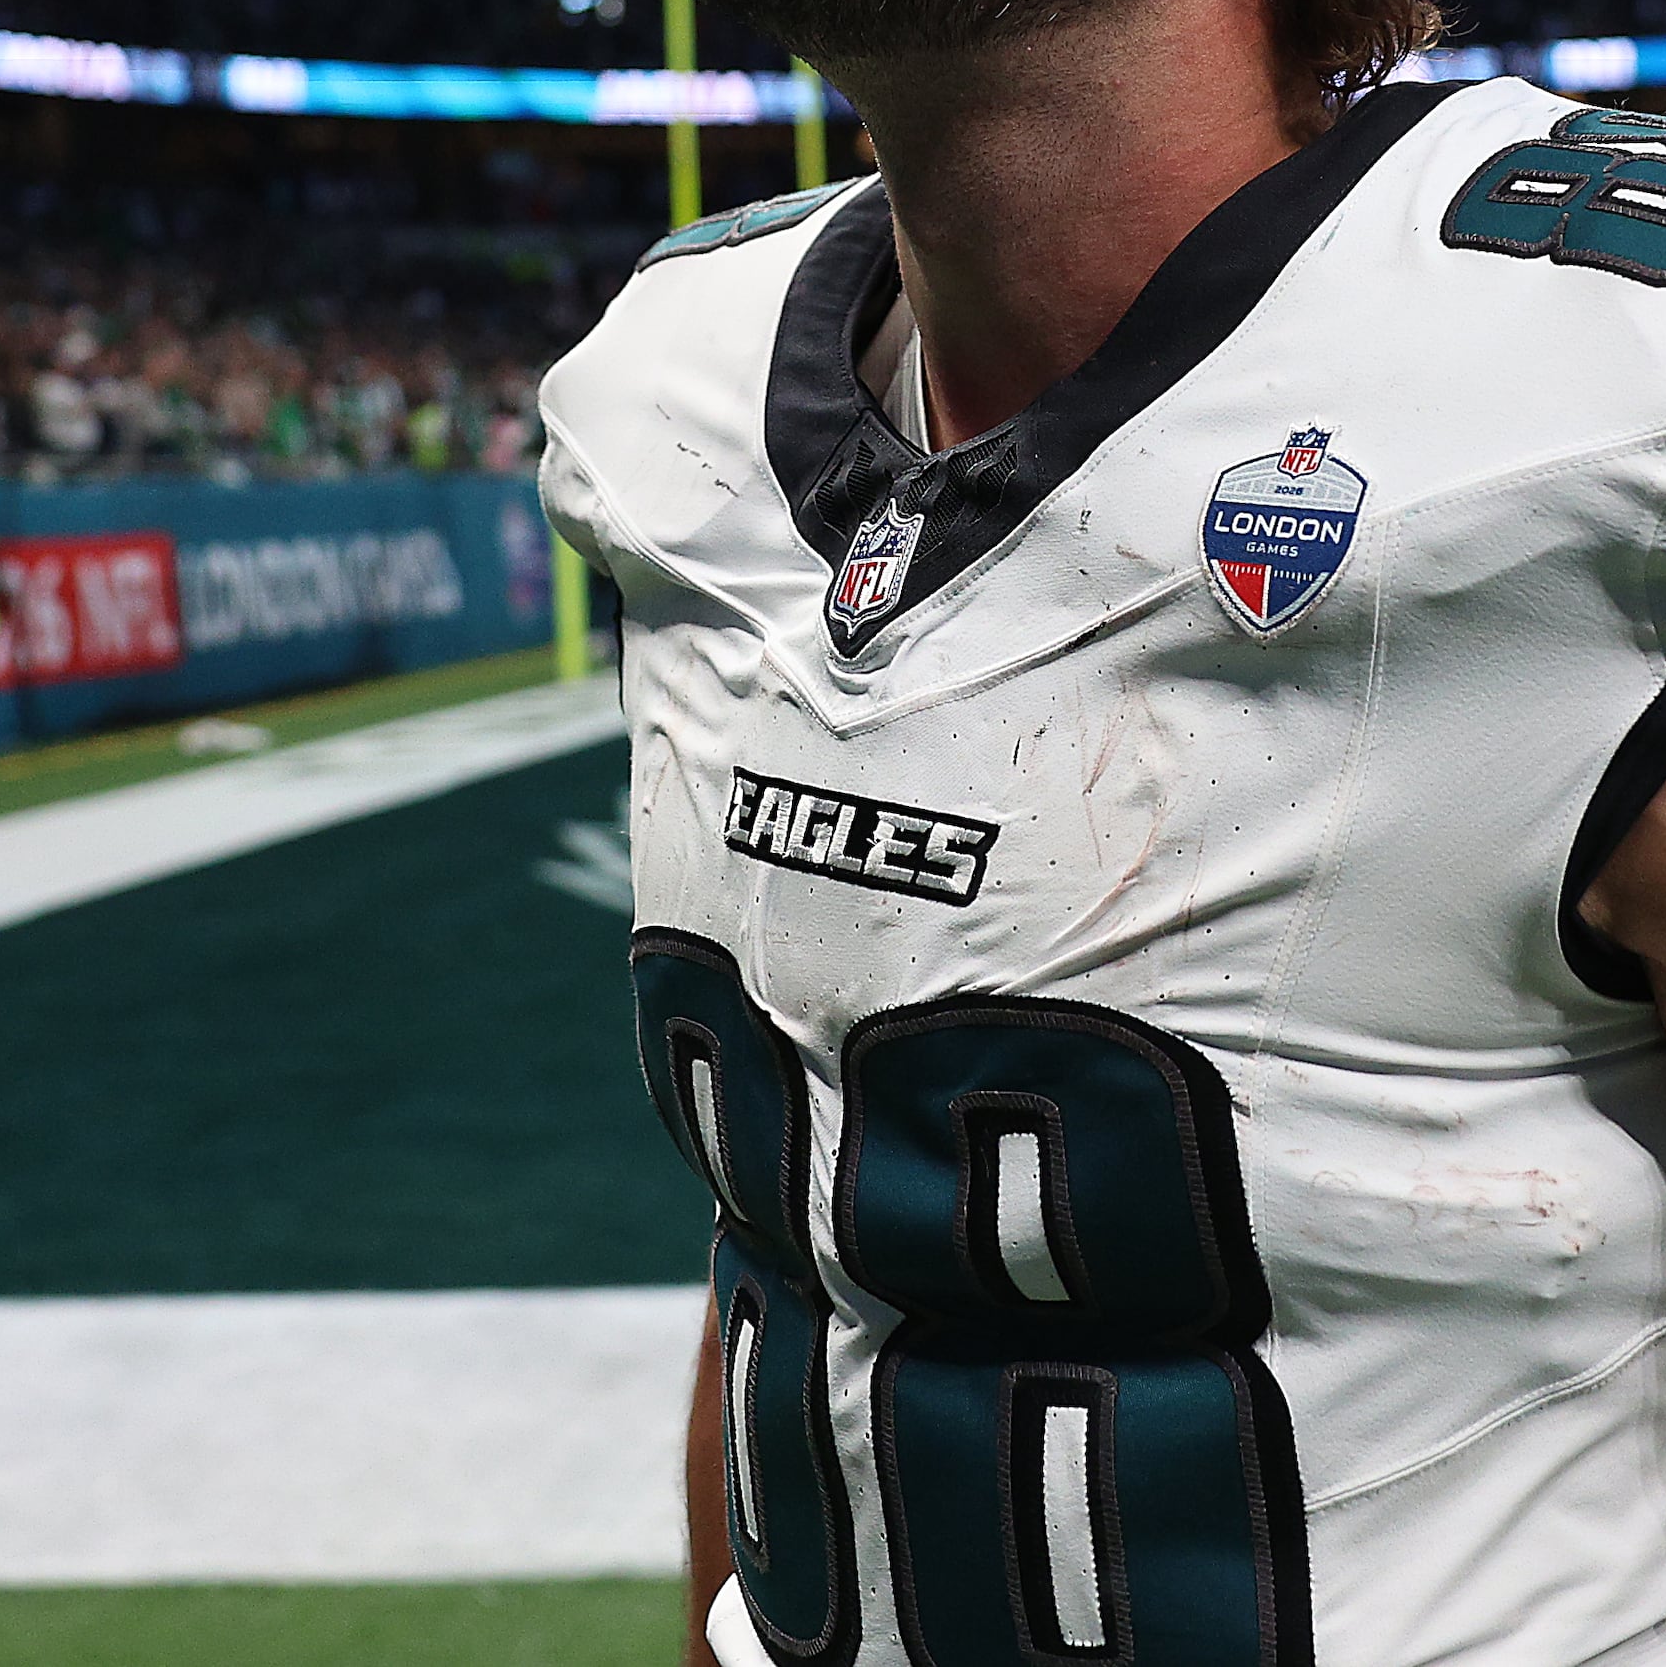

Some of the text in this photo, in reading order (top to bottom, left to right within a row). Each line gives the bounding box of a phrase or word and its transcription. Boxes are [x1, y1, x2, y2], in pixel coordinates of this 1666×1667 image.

[1281, 448, 1318, 474] NFL
[1214, 511, 1344, 544] LONDON
[1246, 541, 1299, 558] GAMES
[838, 561, 888, 611] NFL
[728, 776, 986, 896] EAGLES
[629, 925, 1317, 1667] 88
